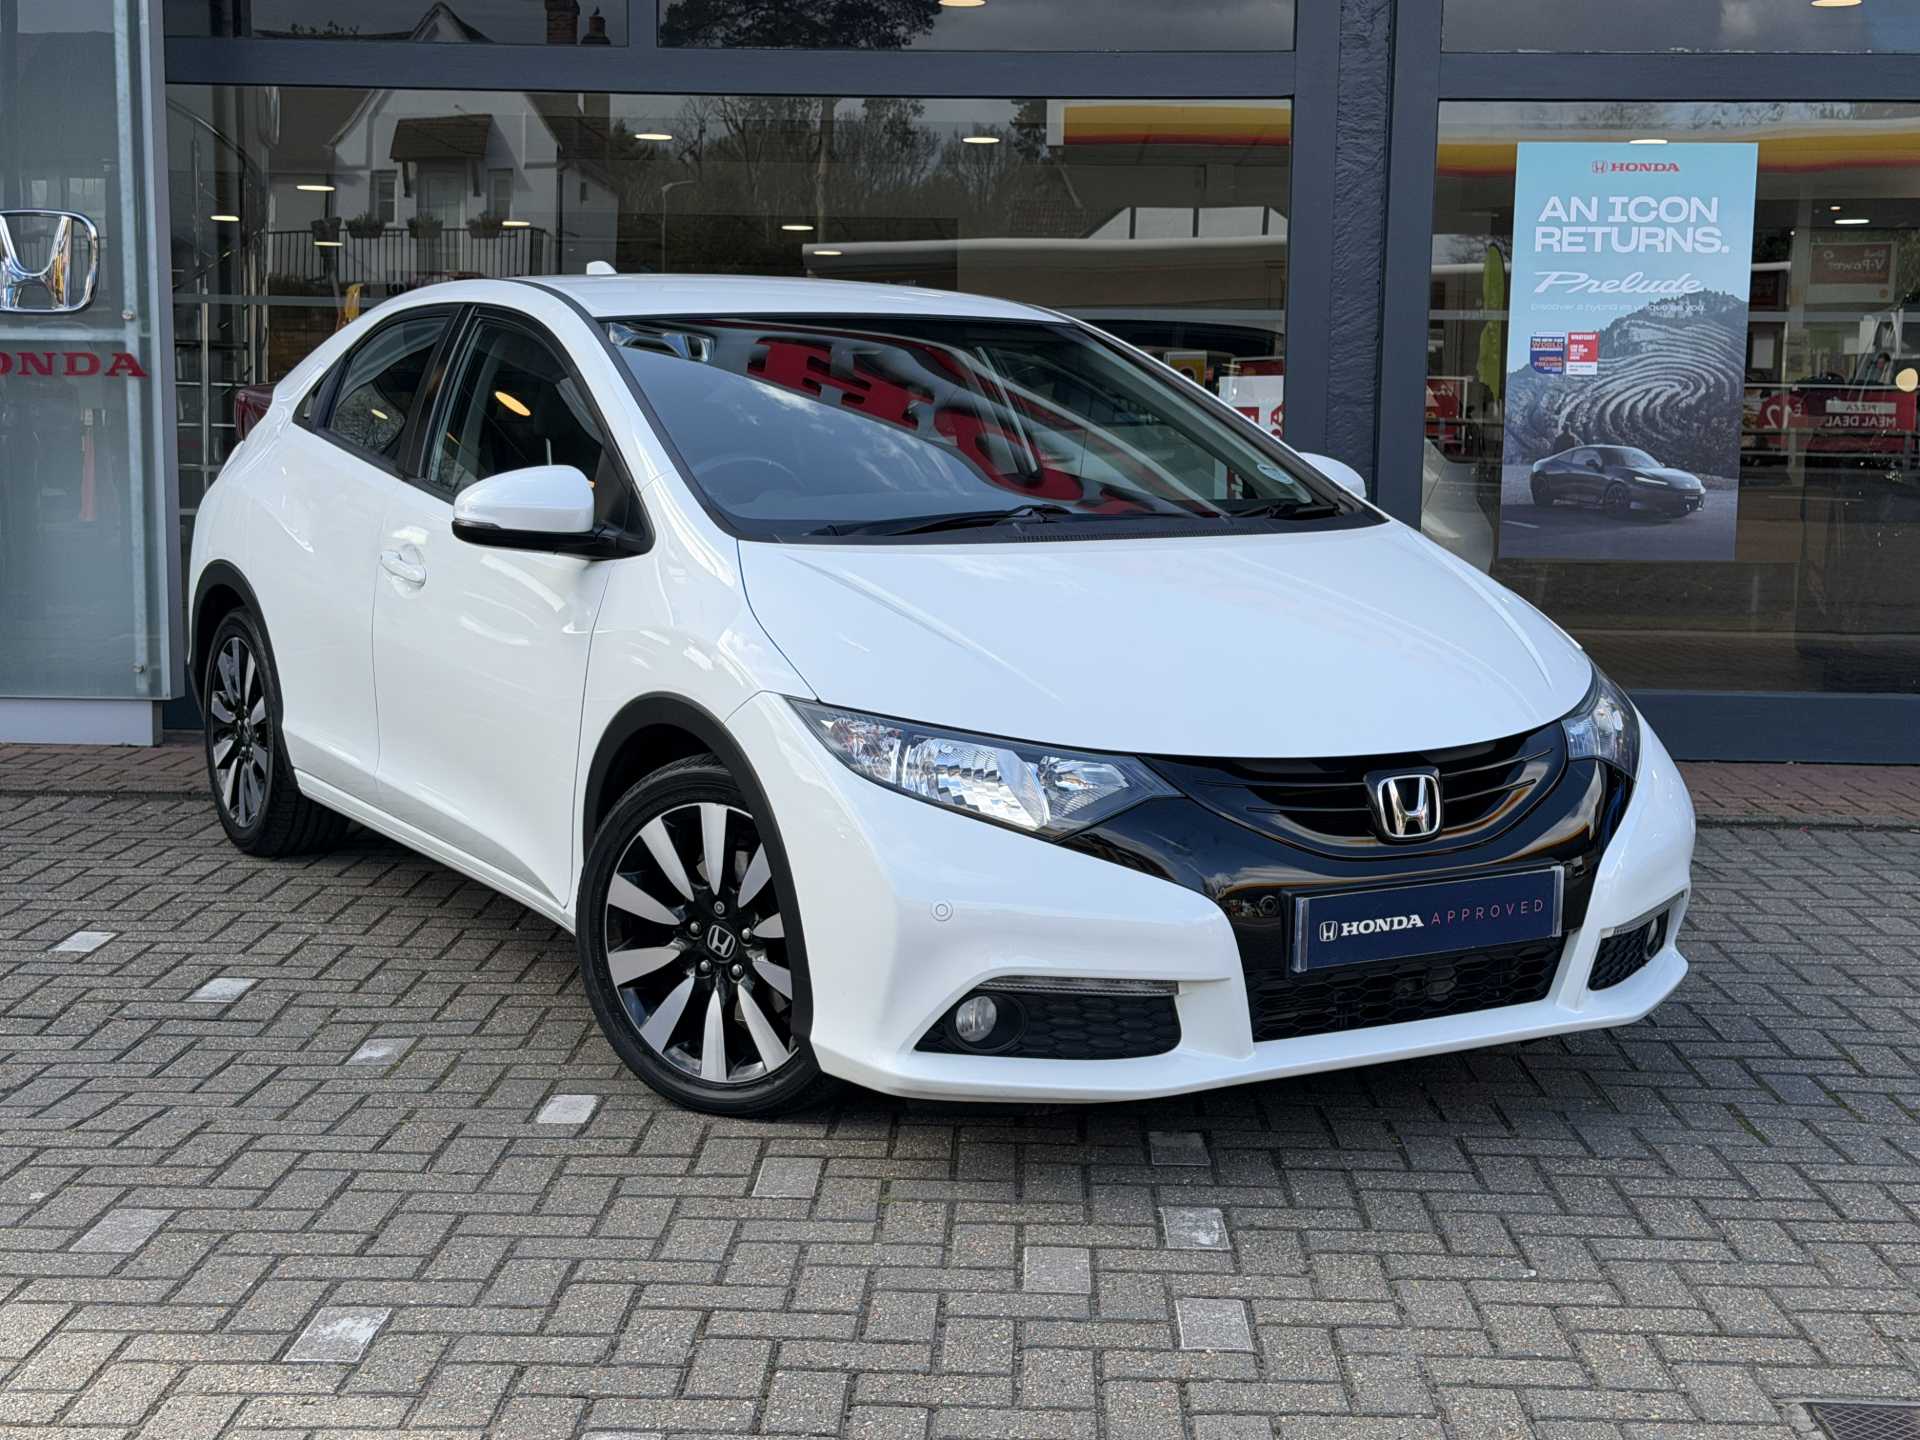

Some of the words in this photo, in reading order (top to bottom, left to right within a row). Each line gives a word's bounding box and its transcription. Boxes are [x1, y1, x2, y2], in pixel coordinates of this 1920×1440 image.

[1611, 162, 1680, 173] HONDA
[1538, 196, 1598, 222] AN
[1608, 196, 1719, 223] ICON
[1535, 226, 1730, 253] RETURNS.
[1534, 271, 1704, 294] Prelude
[1340, 914, 1425, 937] HONDA
[1431, 898, 1545, 926] APPROVED
